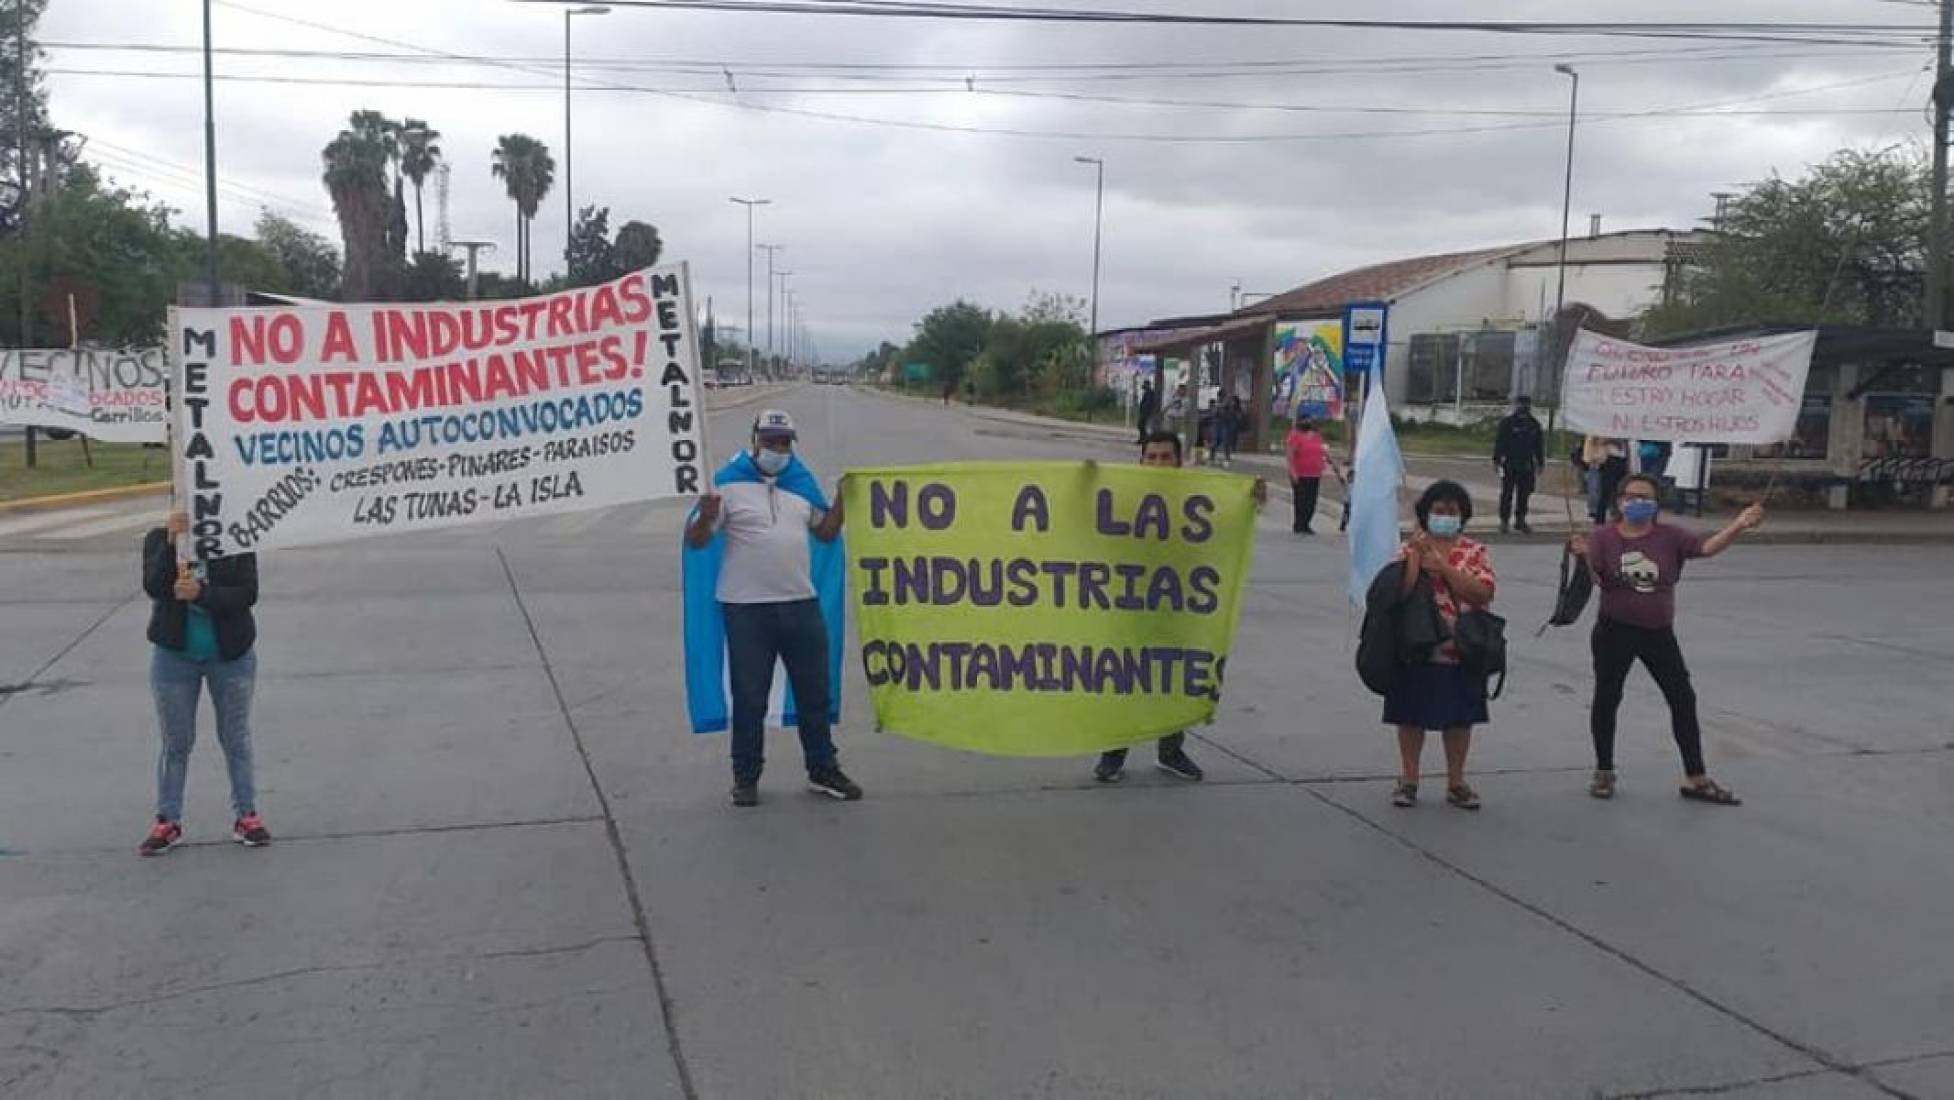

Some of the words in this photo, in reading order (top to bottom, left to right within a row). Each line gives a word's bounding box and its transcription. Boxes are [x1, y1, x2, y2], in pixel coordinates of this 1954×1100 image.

[229, 313, 304, 365] NO
[319, 311, 359, 362] A
[371, 273, 653, 363] INDUSTRIAS
[228, 330, 648, 423] CONTAMINANTES!
[650, 274, 699, 494] METALNOR
[183, 327, 223, 560] METALNOR
[234, 423, 365, 466] VECINOS
[377, 387, 643, 454] AUTOCONVOCADOS
[228, 466, 321, 548] BARRIOS:
[353, 495, 399, 525] LAS
[530, 470, 584, 504] ISLA
[869, 480, 957, 531] NO
[1010, 484, 1049, 532] A
[1094, 488, 1216, 543] LAS
[859, 556, 1221, 614] INDUSTRIAS
